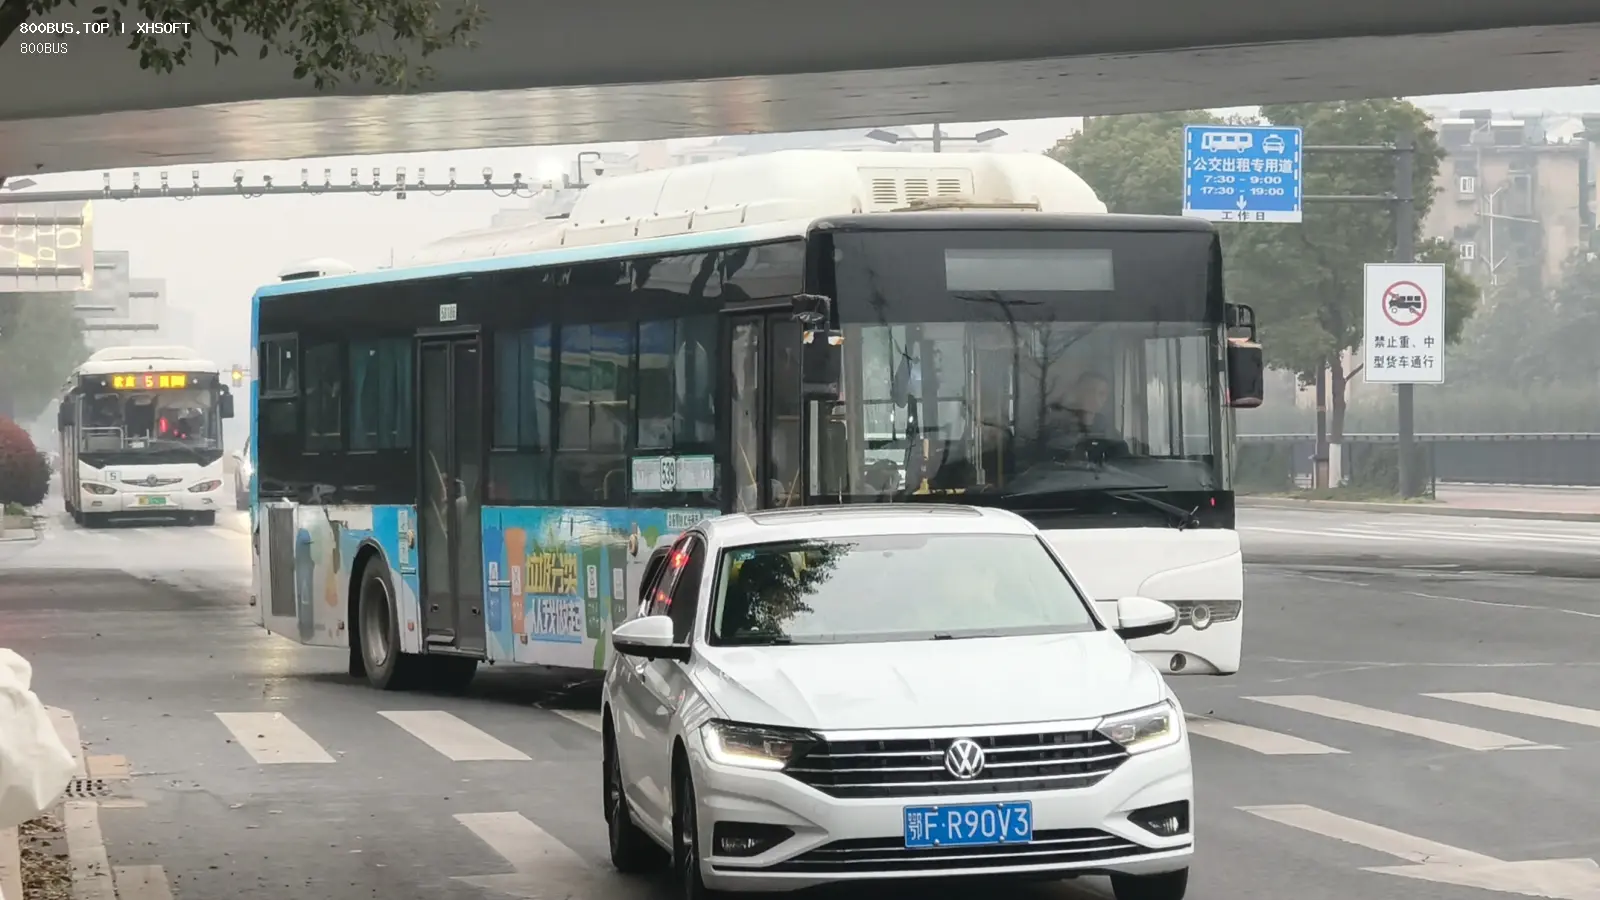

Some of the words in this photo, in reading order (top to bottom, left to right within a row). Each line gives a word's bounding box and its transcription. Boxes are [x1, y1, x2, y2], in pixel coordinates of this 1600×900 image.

[1193, 157, 1293, 174] 公交出租专用道
[1203, 175, 1235, 184] 7:30
[1250, 176, 1282, 185] 9:00
[1201, 186, 1234, 195] 17:30
[1251, 187, 1285, 196] 19:00
[1221, 211, 1265, 221] 工作日
[1374, 335, 1435, 349] 禁止重、中
[1373, 355, 1434, 369] 型货车通行
[144, 374, 154, 388] 5
[661, 462, 675, 485] 539
